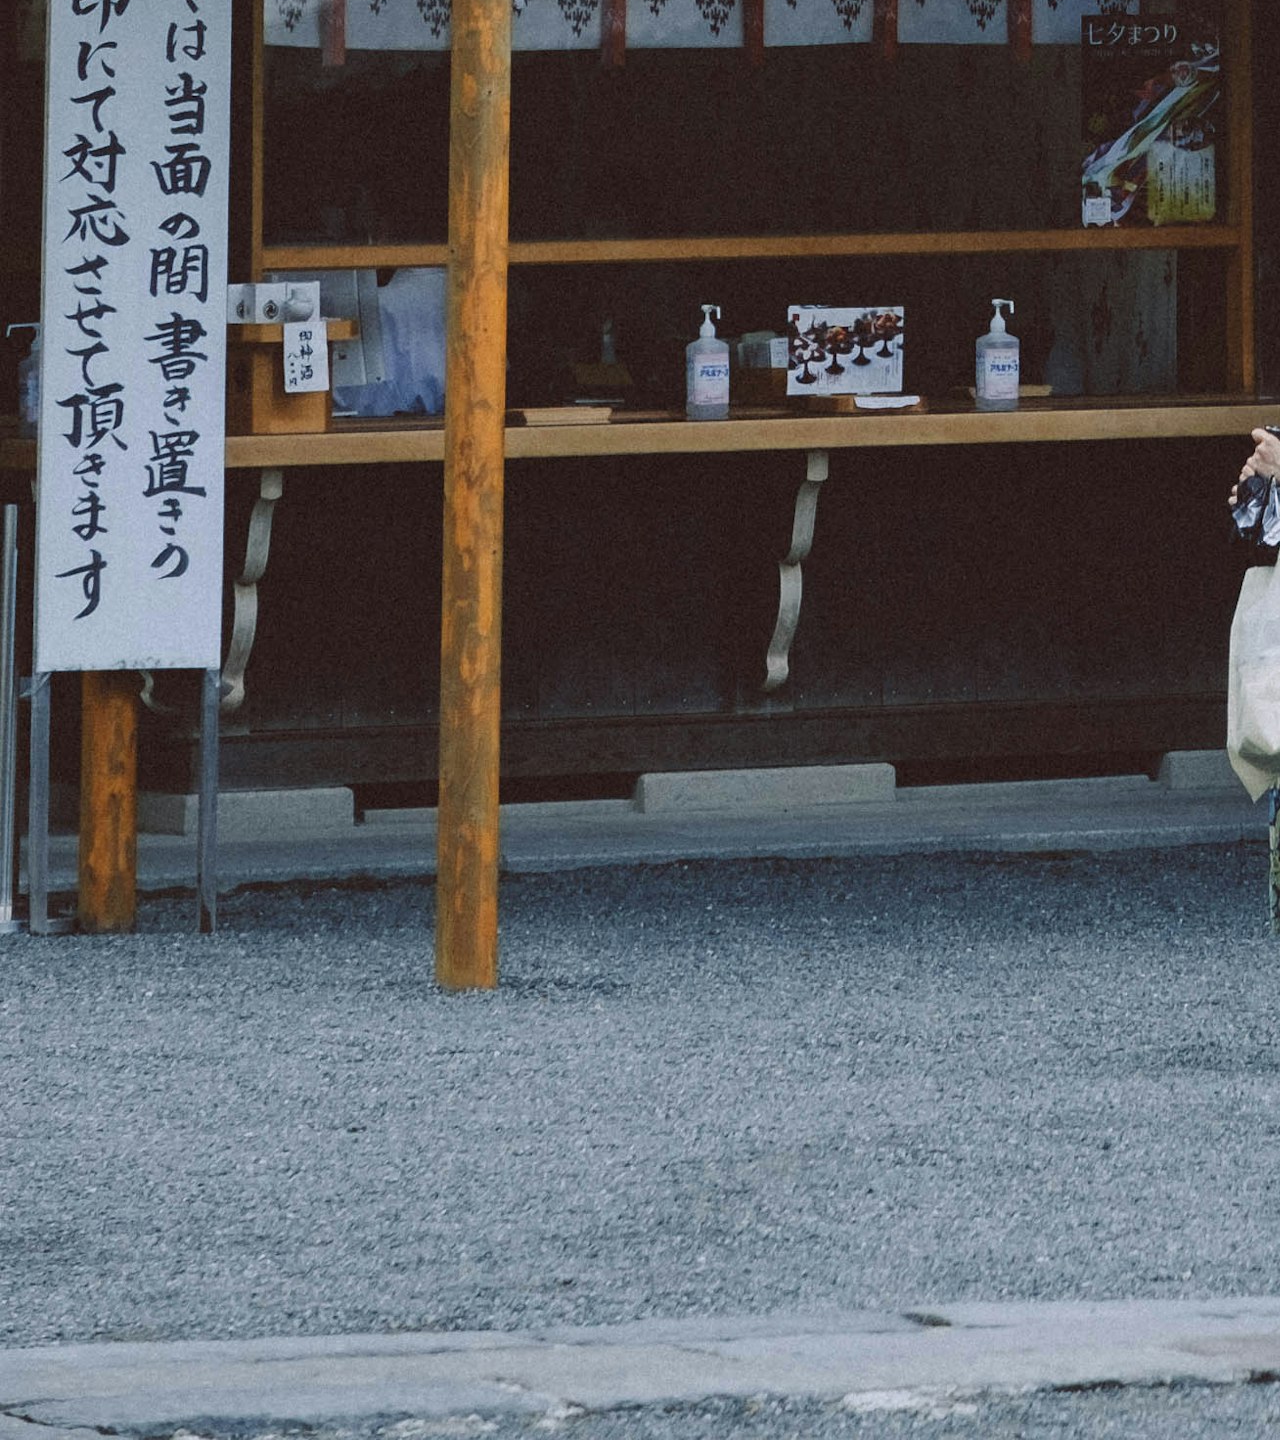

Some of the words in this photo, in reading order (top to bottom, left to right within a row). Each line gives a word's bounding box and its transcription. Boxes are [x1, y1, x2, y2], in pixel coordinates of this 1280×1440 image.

[1089, 22, 1178, 46] 七夕まつり
